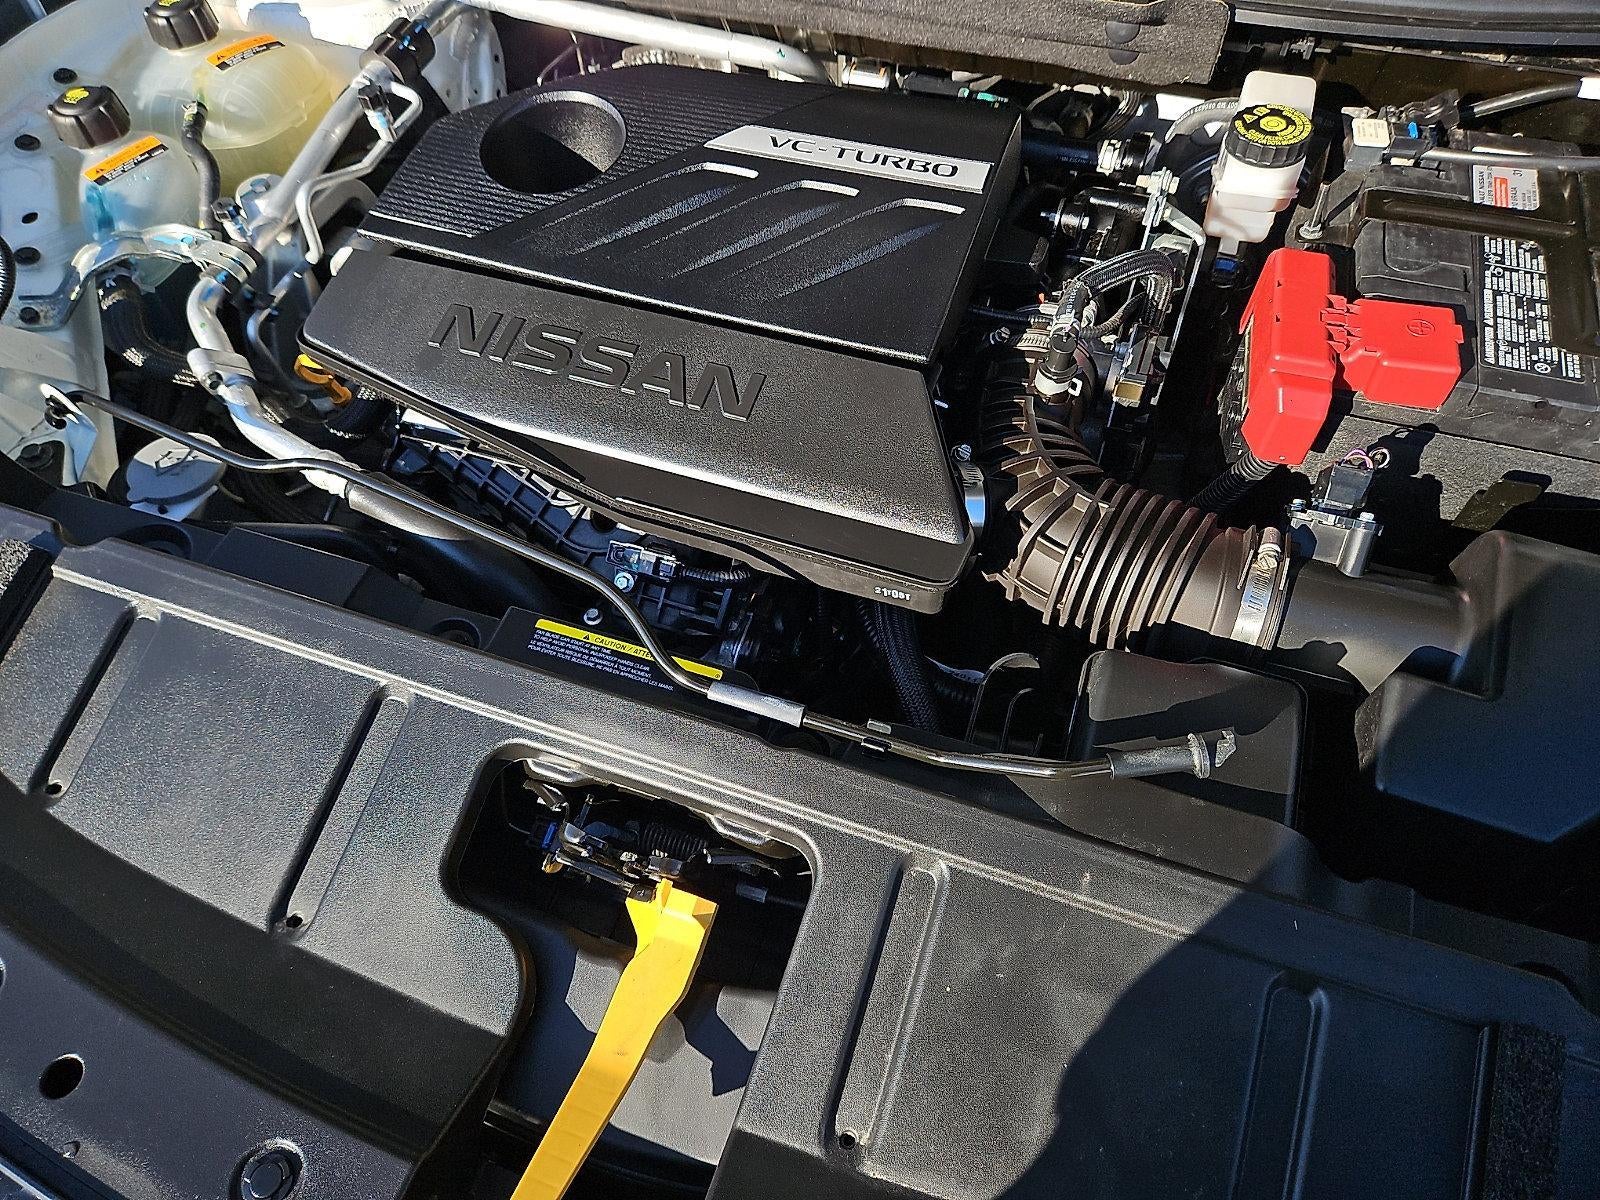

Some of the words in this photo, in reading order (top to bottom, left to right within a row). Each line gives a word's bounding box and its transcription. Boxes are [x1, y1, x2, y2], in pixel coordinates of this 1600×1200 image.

[768, 134, 960, 179] VC-TURBO
[427, 303, 767, 422] NISSAN
[594, 637, 626, 650] CAUTION
